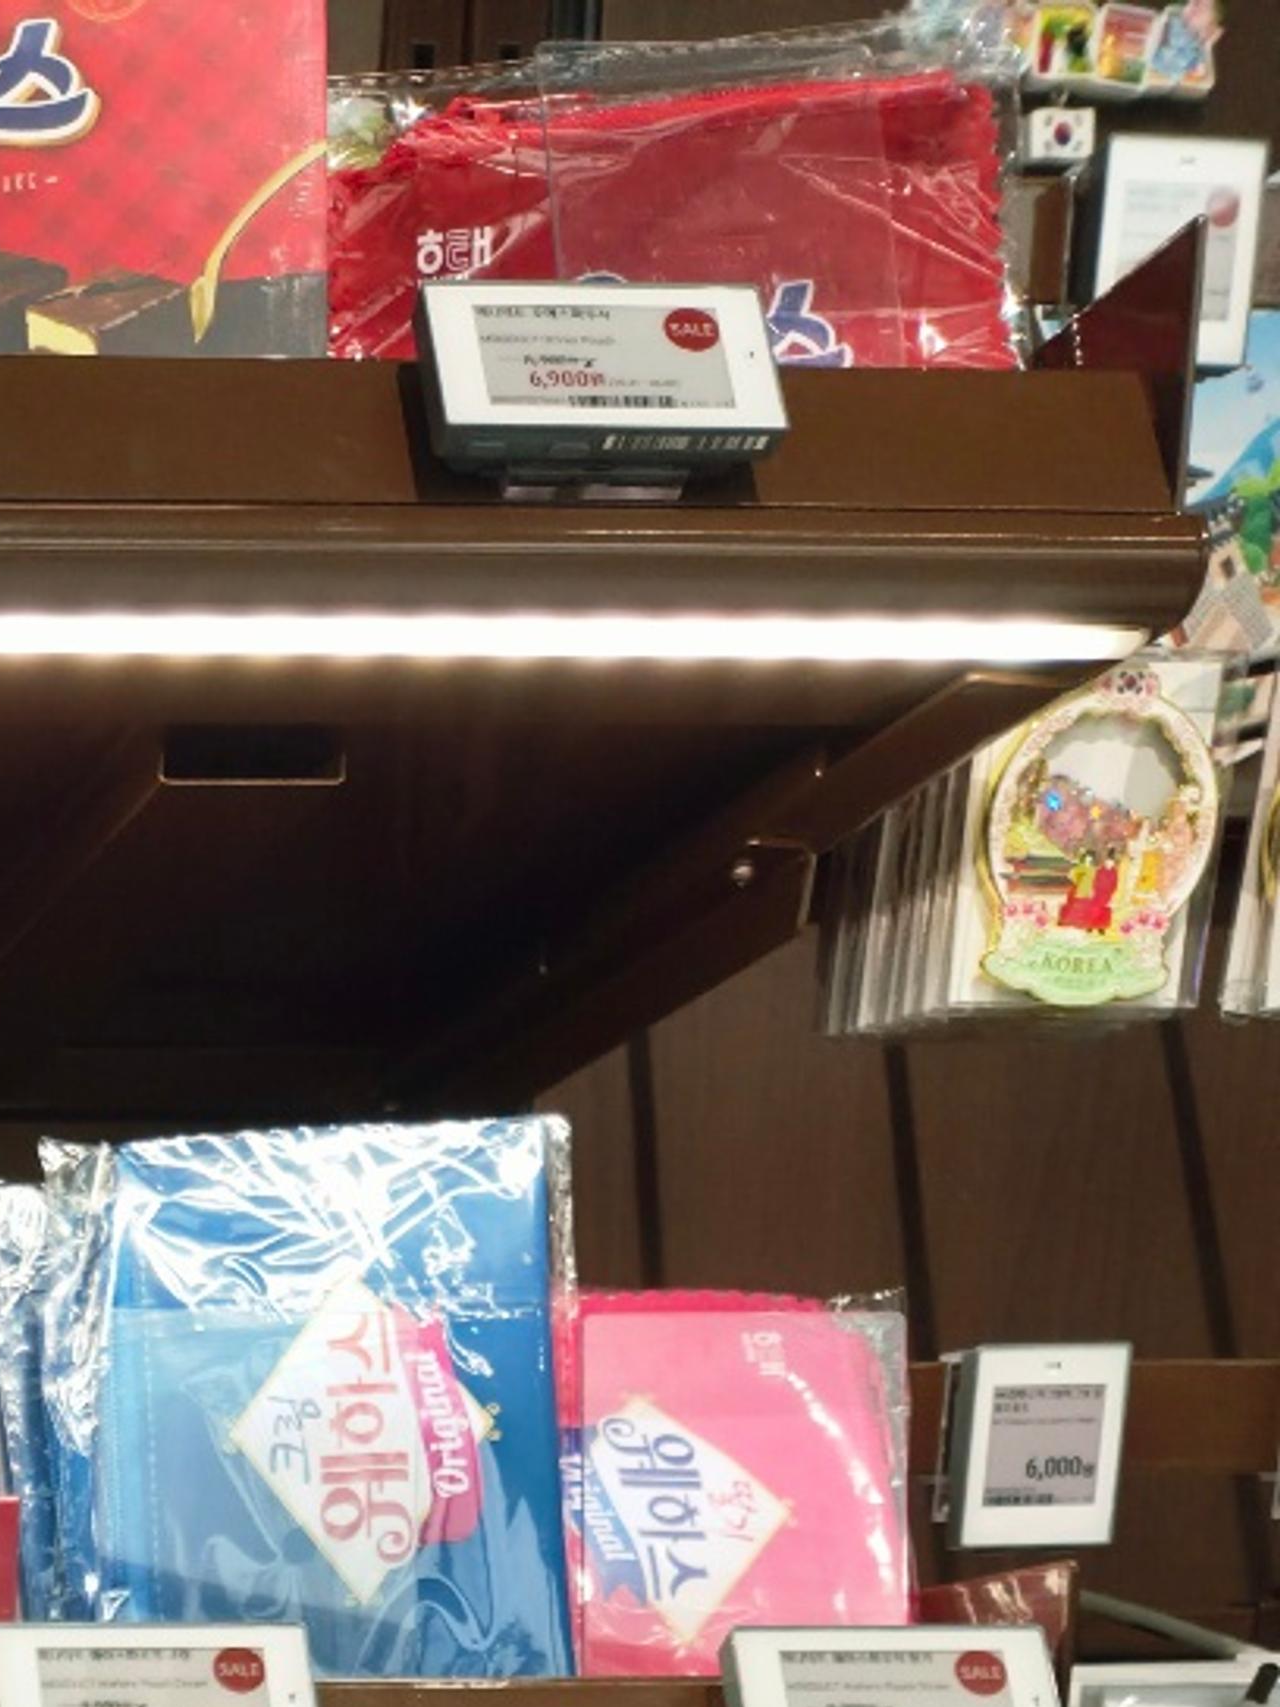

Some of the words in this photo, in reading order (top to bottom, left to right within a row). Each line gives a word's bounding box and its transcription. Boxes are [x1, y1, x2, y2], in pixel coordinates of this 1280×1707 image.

[416, 226, 493, 272] 해태
[669, 323, 715, 337] SALE
[320, 1311, 415, 1562] 웨하스
[404, 1350, 470, 1498] Original
[602, 1418, 708, 1600] 웨하스
[217, 1661, 262, 1677] SALE
[958, 1664, 1003, 1680] SALE
